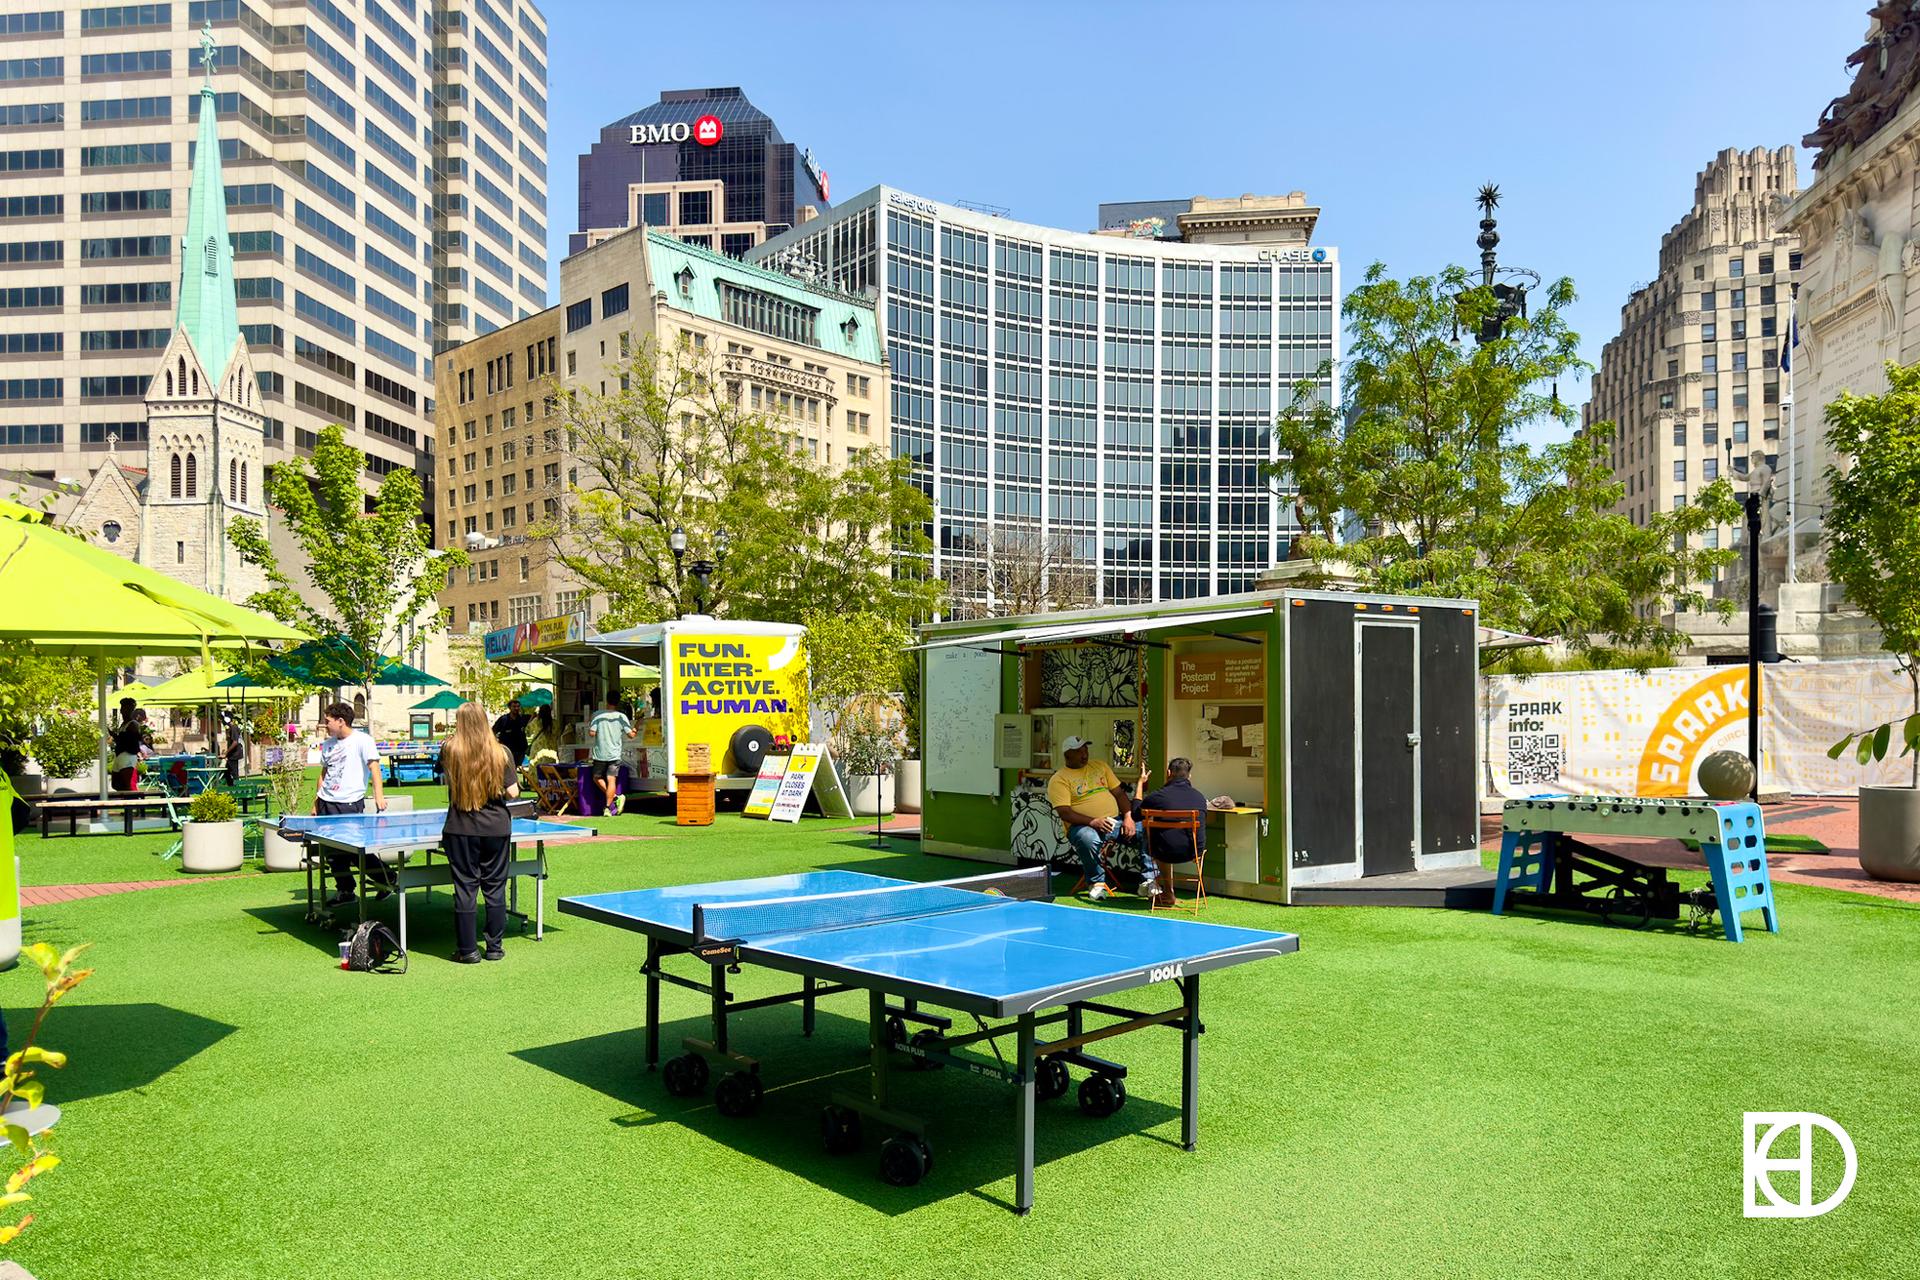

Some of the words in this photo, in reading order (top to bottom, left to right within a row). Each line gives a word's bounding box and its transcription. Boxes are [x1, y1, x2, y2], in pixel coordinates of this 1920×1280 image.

[630, 123, 690, 144] BMO
[890, 192, 938, 216] salesforce
[1258, 249, 1310, 262] CHASE
[485, 633, 511, 655] HELLO!
[679, 643, 750, 658] FUN.
[680, 662, 762, 677] INTER-
[1181, 661, 1195, 671] The
[1181, 672, 1216, 682] Postcard
[681, 680, 780, 695] ACTIVE.
[1181, 684, 1209, 695] Project
[681, 699, 794, 715] HUMAN.
[1509, 701, 1562, 716] SPARK
[1509, 718, 1544, 732] info:
[1650, 679, 1749, 784] SPARK
[1717, 728, 1749, 747] CIRCL
[781, 789, 788, 797] AT
[785, 781, 806, 790] CLOSES
[701, 947, 732, 956] ComeSee
[1149, 963, 1184, 984] JOOLA
[895, 1042, 911, 1054] NOVA
[911, 1048, 926, 1058] PLUS
